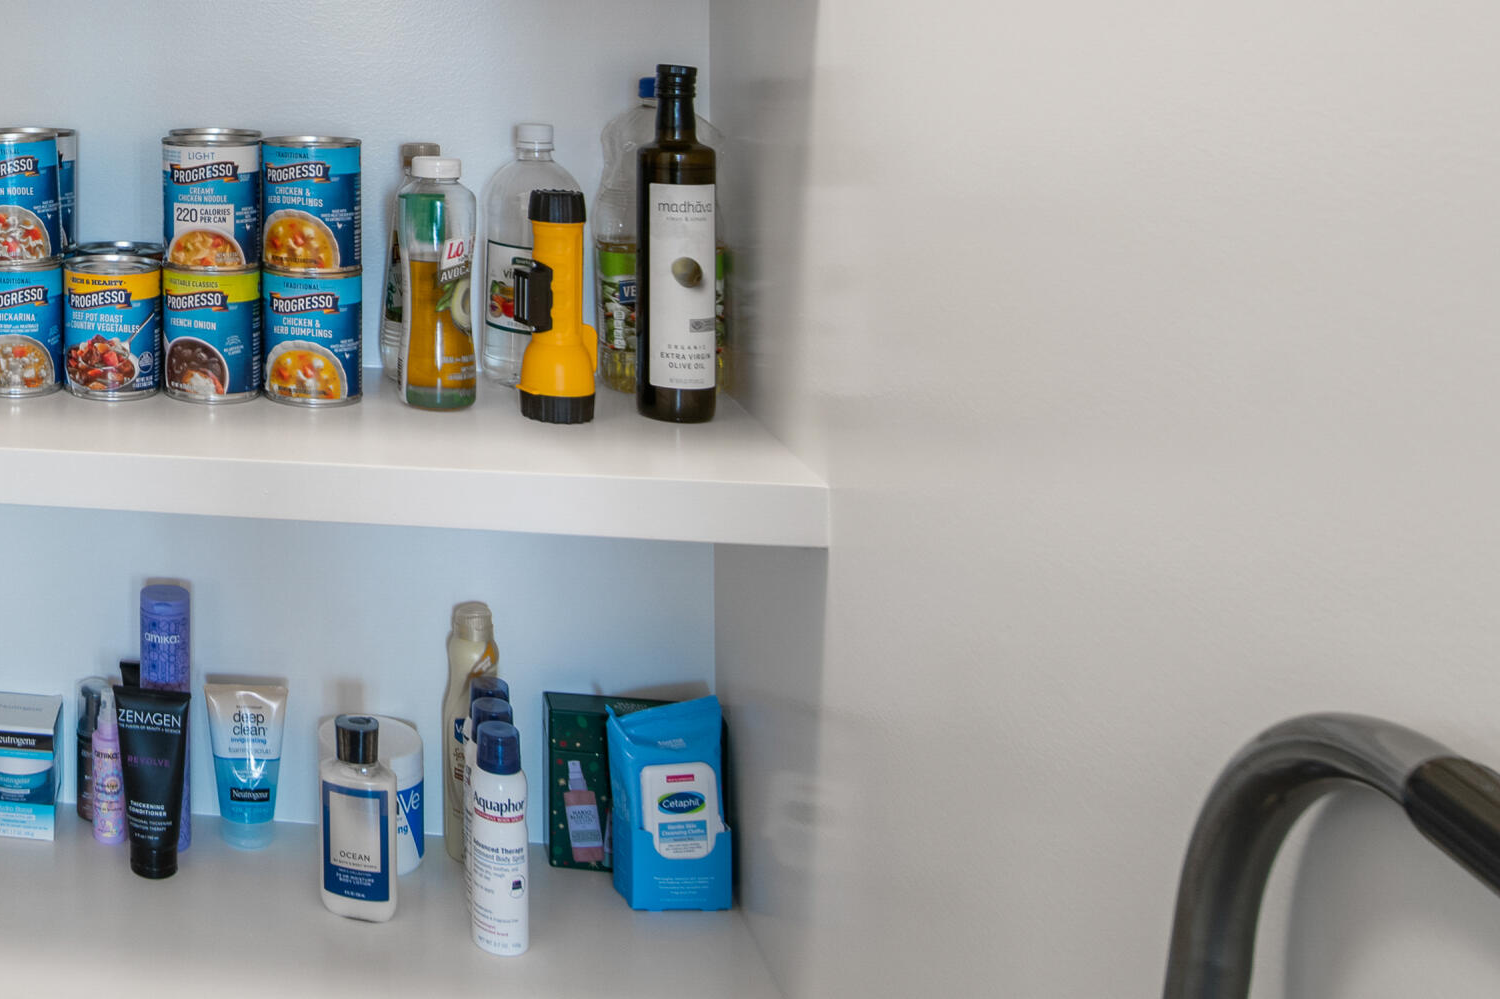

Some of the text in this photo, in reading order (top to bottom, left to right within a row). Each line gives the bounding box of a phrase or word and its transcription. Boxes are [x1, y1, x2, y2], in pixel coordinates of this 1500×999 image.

[188, 152, 216, 160] LIGHT
[174, 164, 233, 182] PROGRESSO
[268, 164, 324, 182] PROGRESSO
[7, 187, 34, 196] NOODLE
[276, 186, 310, 196] CHICKEN &
[178, 194, 202, 202] CHICKEN
[268, 196, 324, 208] HERB DUMPLINGS
[176, 207, 230, 222] 220 CALORIES
[200, 216, 212, 224] PER
[284, 282, 320, 290] TRADITIONAL
[70, 290, 125, 308] PROGRESSO
[168, 293, 221, 309] PROGRESSO
[273, 295, 333, 312] PROGRESSO
[72, 312, 124, 323] BEEF POT ROAST
[282, 317, 320, 328] CHICKEN &
[71, 322, 140, 334] COUNTRY VEGETABLES
[170, 318, 217, 330] FRENCH ONION
[274, 326, 333, 338] HERB DUMPLINGS
[660, 352, 686, 360] EXTRA
[668, 362, 706, 370] OLIVE OIL
[144, 632, 180, 645] amika:
[233, 710, 264, 726] deep
[232, 722, 266, 736] clean
[127, 756, 170, 768] REVOLVE
[232, 788, 268, 800] Neutrogena
[130, 800, 164, 810] THICKENING
[474, 791, 524, 816] Aquaphor
[662, 798, 700, 808] Cetaphil
[129, 806, 167, 816] CONDITIONER
[473, 838, 500, 854] Advanced
[340, 850, 370, 862] OCEAN
